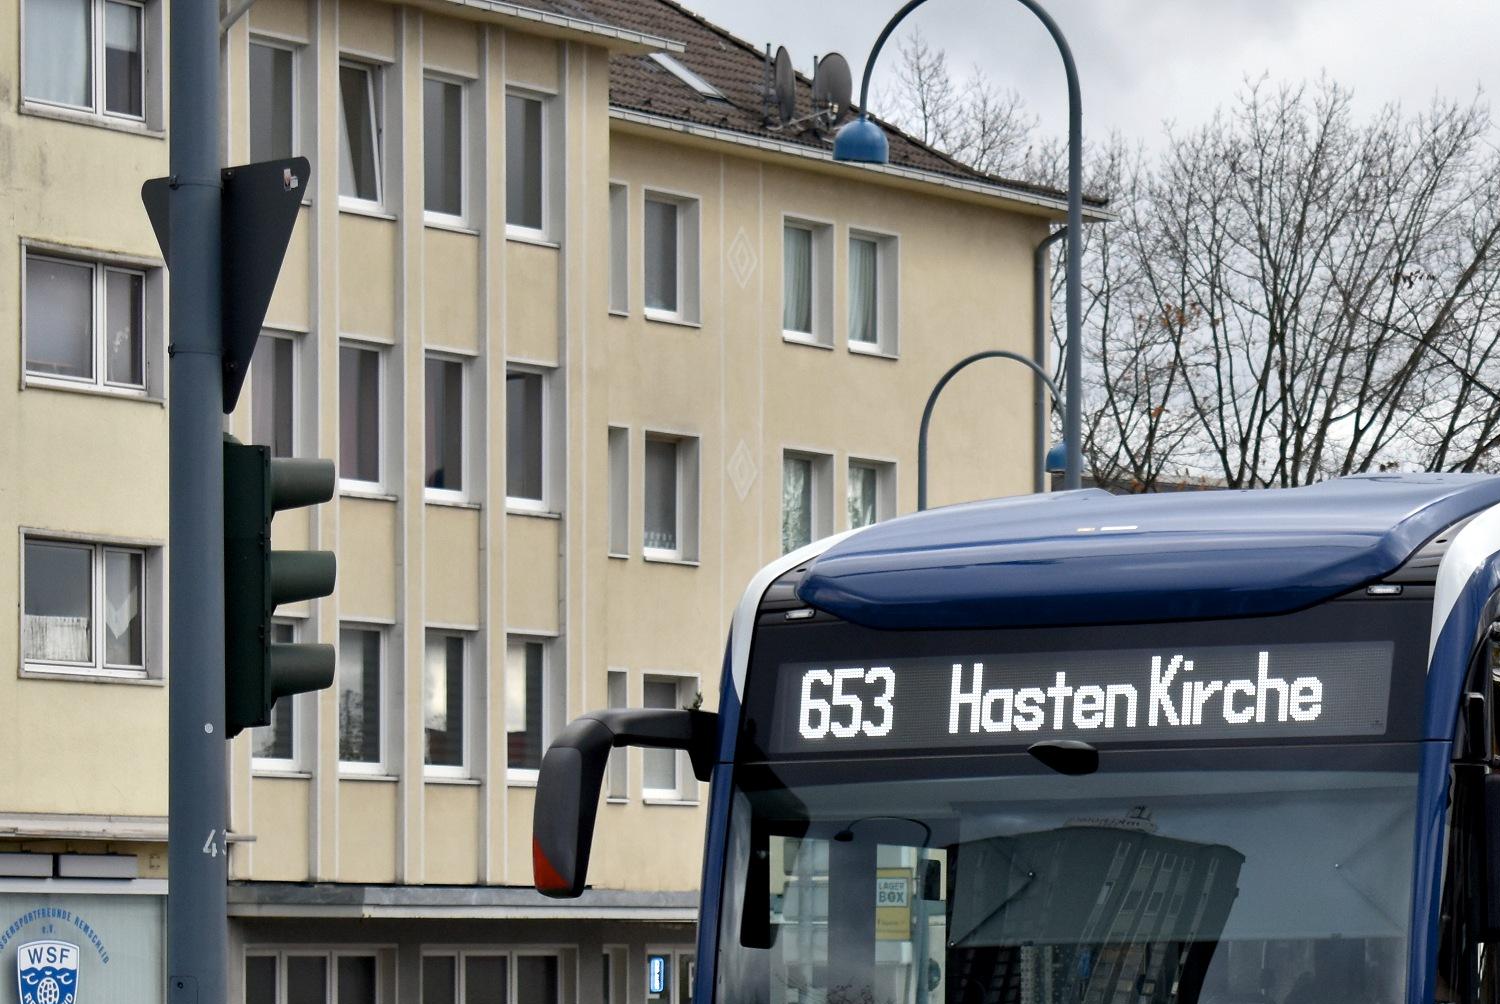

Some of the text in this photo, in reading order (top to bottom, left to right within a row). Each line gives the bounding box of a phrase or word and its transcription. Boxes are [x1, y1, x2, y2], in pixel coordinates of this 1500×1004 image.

[800, 651, 1323, 739] 653 Hasten Kirche
[878, 892, 904, 903] BOX
[27, 946, 70, 965] WSF
